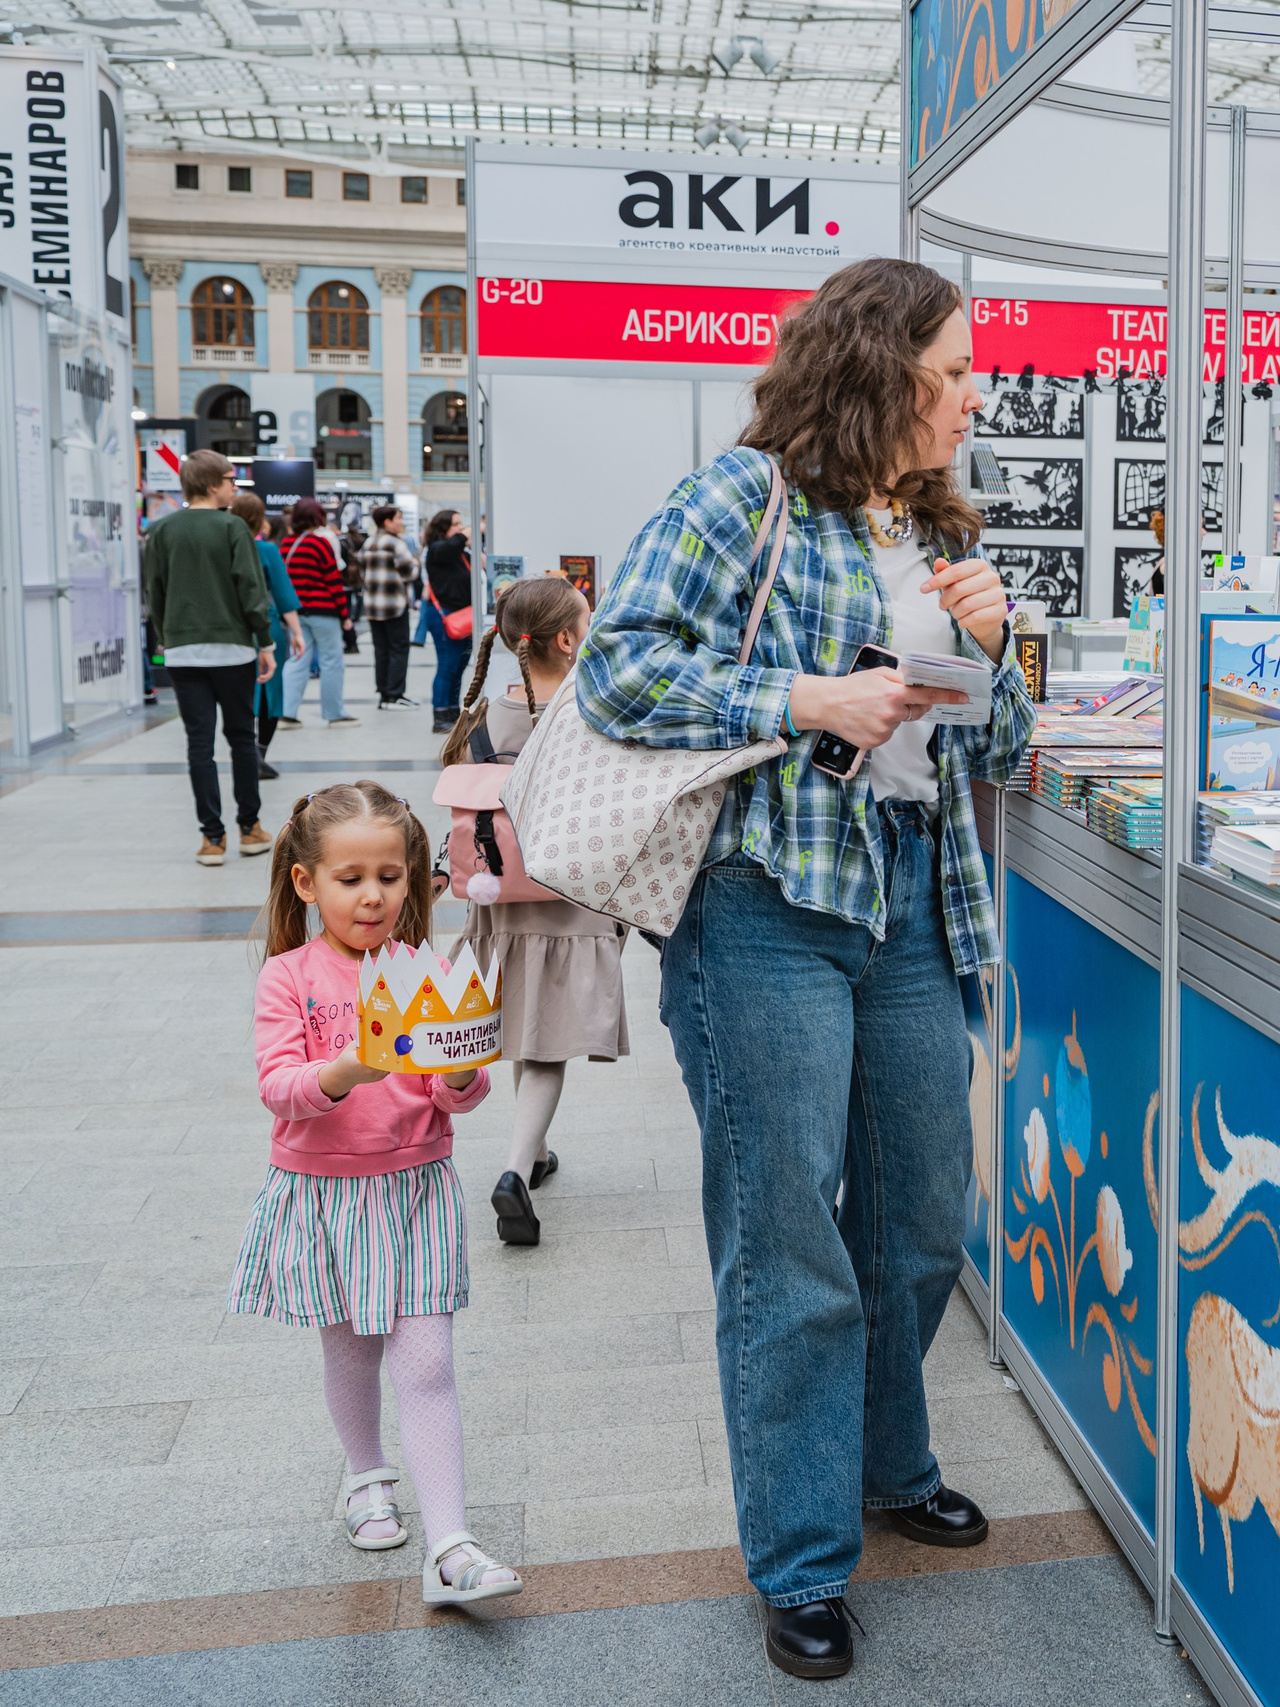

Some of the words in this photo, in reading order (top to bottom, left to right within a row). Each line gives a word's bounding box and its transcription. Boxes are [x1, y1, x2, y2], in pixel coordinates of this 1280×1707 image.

[619, 239, 685, 250] агентство
[689, 242, 767, 254] креативных
[771, 245, 840, 257] индустрий
[482, 278, 543, 305] G-20
[974, 299, 1029, 326] G-15
[1096, 346, 1222, 382] SHADW
[443, 1036, 496, 1059] ЧИТАТЕЛЬ
